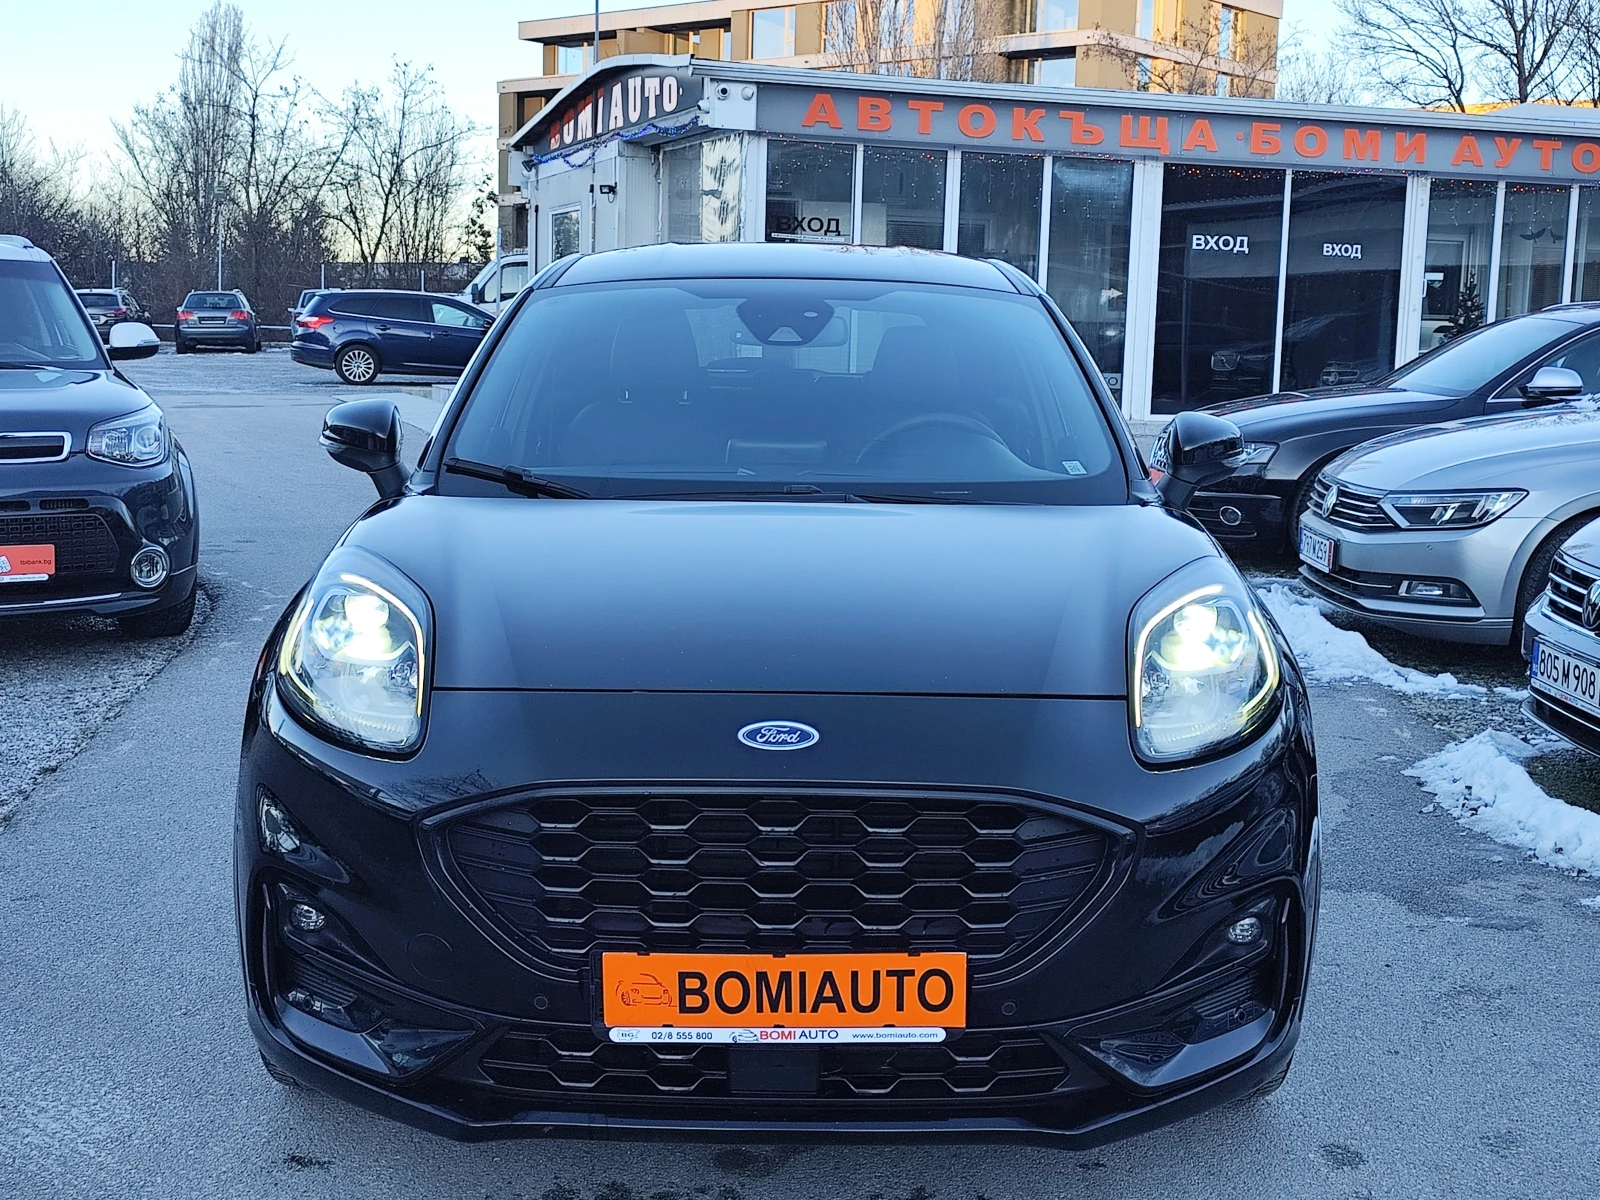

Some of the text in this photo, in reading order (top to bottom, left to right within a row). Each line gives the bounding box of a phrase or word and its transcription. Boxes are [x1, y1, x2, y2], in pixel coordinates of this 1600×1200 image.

[802, 93, 1600, 174] АВТОКЪЩА БОМИ АУТО
[777, 216, 841, 236] ВХОД
[1192, 234, 1249, 254] ВХОД
[1322, 243, 1362, 260] ВХОД
[756, 726, 801, 743] Ford
[677, 968, 955, 1015] BOMIAUTO
[651, 1031, 713, 1041] 02/8 555 800
[759, 1029, 839, 1040] BOMI AUTO
[852, 1031, 938, 1039] www.bomiauto.com
